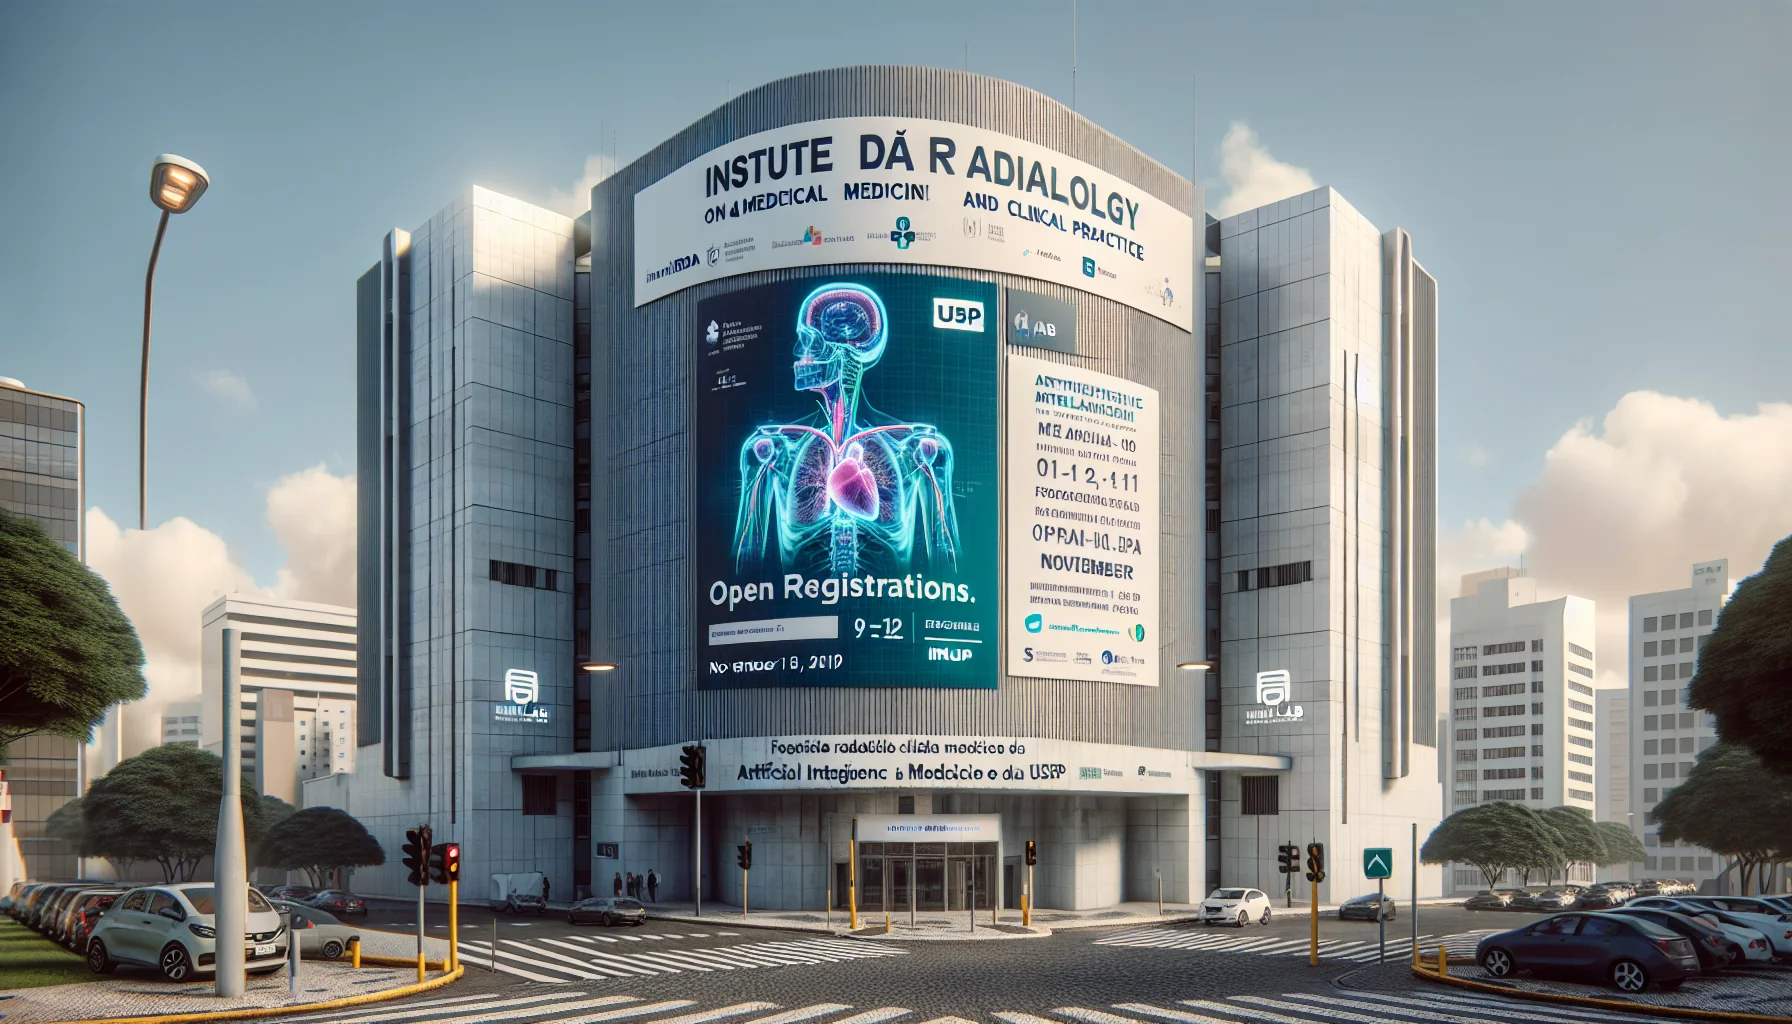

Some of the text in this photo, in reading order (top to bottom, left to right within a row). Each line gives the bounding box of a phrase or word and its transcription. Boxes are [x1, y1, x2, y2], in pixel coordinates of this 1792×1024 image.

[706, 136, 833, 198] INSTUTE
[704, 203, 726, 224] ON
[963, 191, 999, 212] AND
[709, 573, 976, 612] Open Registrations.
